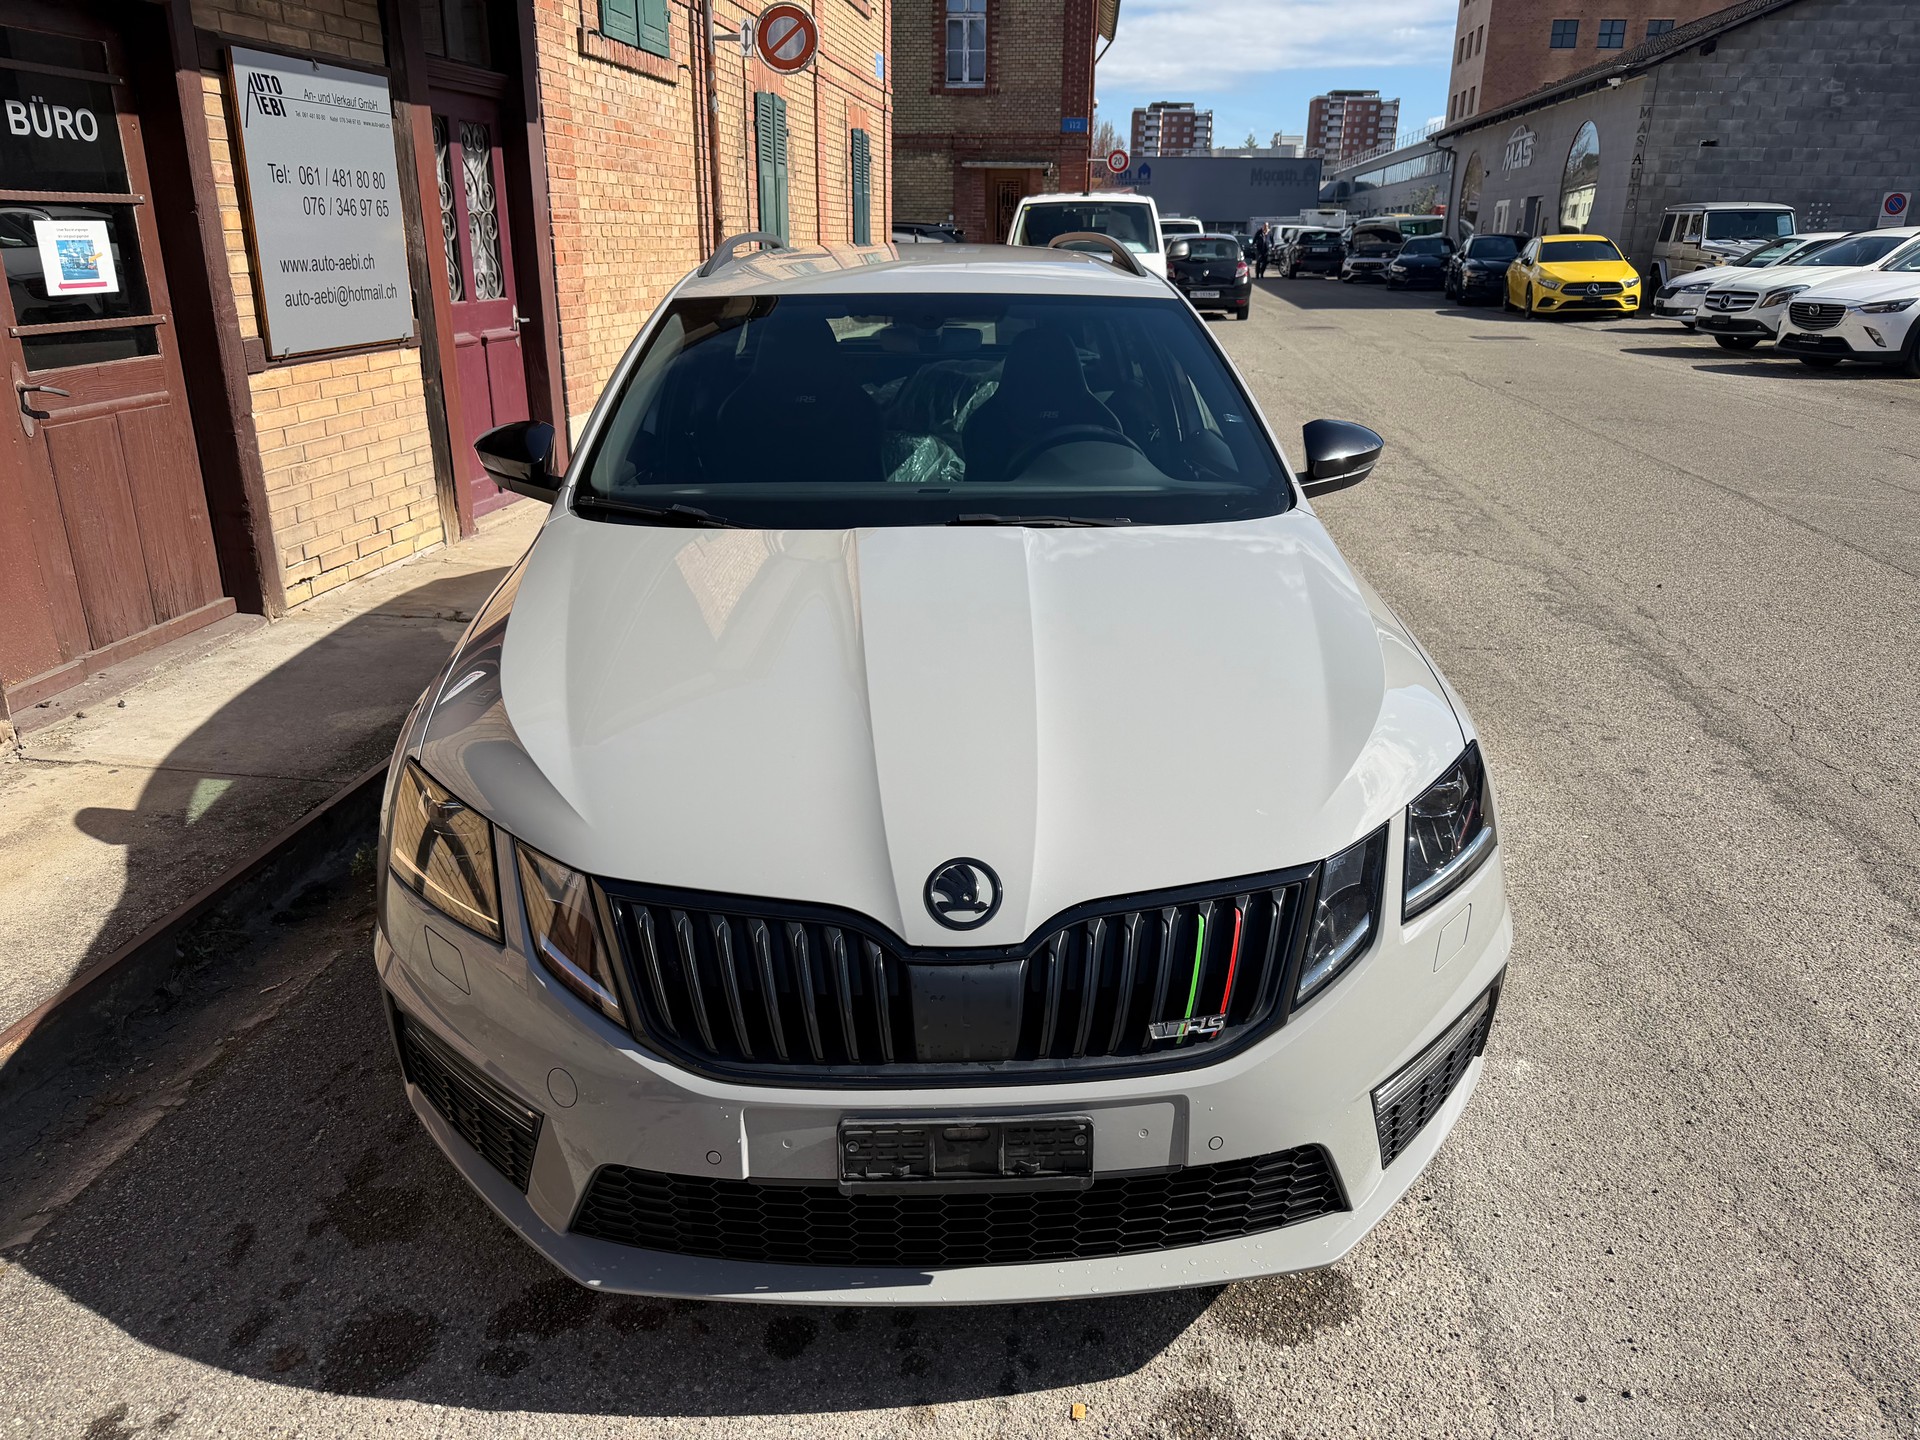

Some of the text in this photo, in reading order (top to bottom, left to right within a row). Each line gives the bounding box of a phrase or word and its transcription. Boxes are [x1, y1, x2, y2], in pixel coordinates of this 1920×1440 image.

[246, 72, 283, 96] AUTO
[303, 88, 379, 111] An- und Verkauf GmbH
[5, 95, 98, 142] BÜRO
[1114, 157, 1123, 166] 20
[267, 163, 386, 190] Tel: 061 / 481 80 80
[303, 196, 389, 217] 076 / 346 97 65
[280, 253, 375, 273] www.auto-aebi.ch
[285, 283, 398, 307] auto-aebi@hotmail.ch
